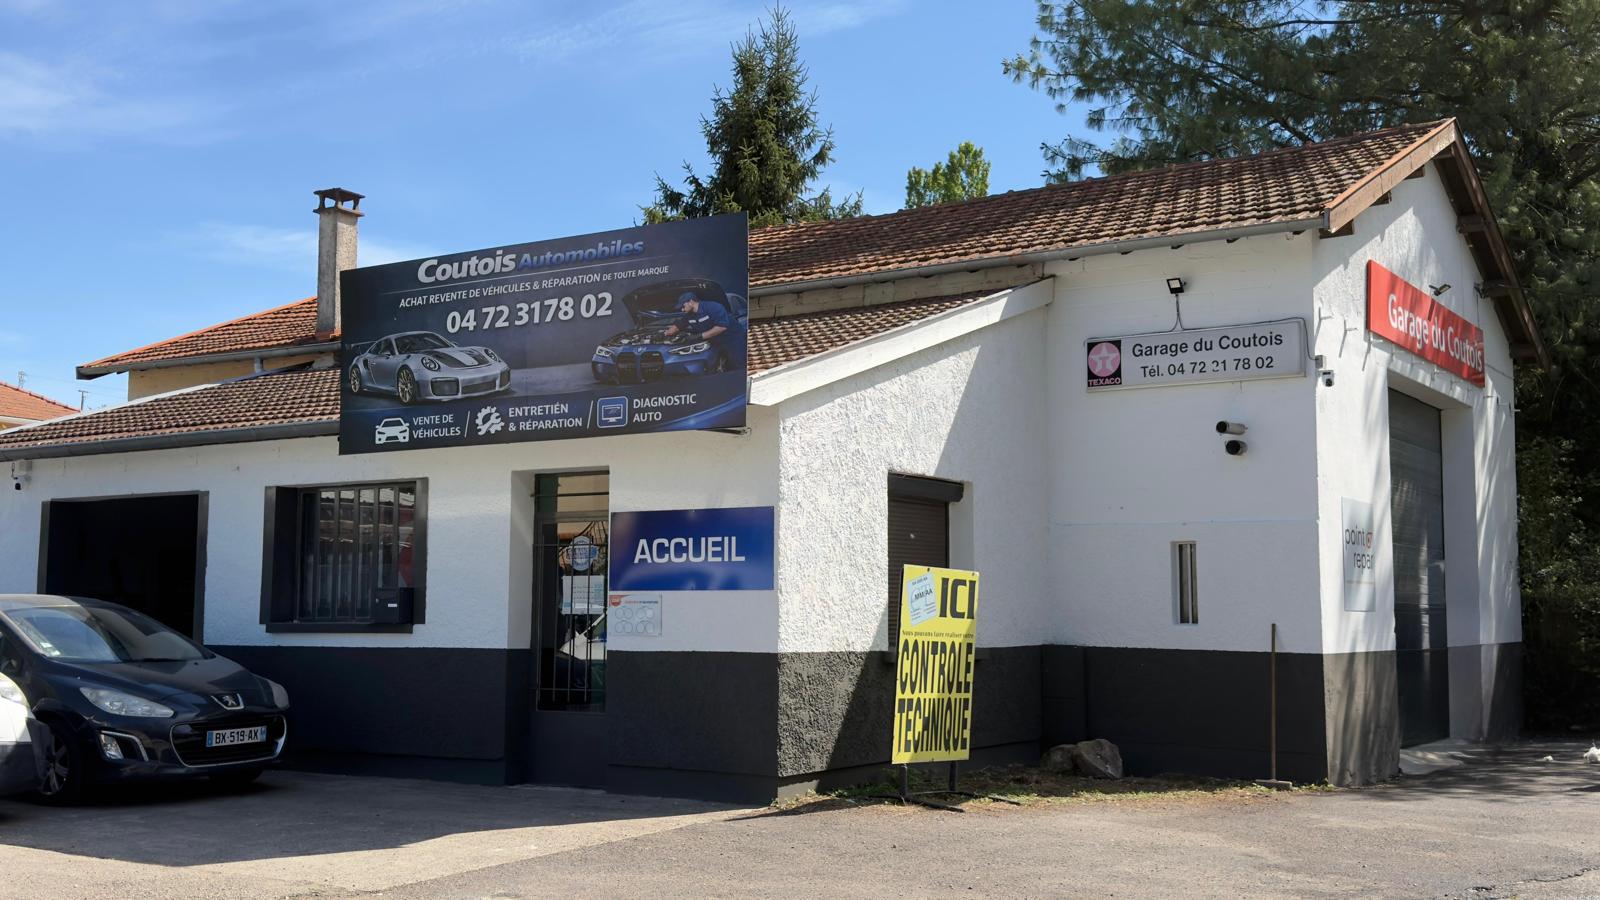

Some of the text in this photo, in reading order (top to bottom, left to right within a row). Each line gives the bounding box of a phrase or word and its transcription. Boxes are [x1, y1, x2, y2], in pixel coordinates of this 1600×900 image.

[417, 239, 645, 283] Coutois Automobiles
[399, 265, 670, 308] ACHAT REVENTE DE VÉHICULES & RÉPARATION DE TOUTE MARQUE
[446, 309, 477, 334] 04
[481, 305, 510, 330] 72
[580, 291, 613, 319] 02
[1132, 332, 1283, 357] Garage du Coutois
[1388, 294, 1483, 373] Garage du Coutois
[1141, 364, 1164, 378] Tél.
[1167, 362, 1185, 376] 04
[1190, 361, 1207, 374] 72
[1233, 357, 1251, 370] 78
[1255, 356, 1274, 369] 02
[1088, 377, 1121, 387] TEXACO
[633, 393, 697, 409] DIAGNOSTIC
[413, 414, 454, 426] VENTE DE
[508, 417, 583, 432] & RÉPARATION
[632, 411, 662, 423] AUTO
[412, 426, 461, 439] VÉHICULES
[633, 536, 746, 564] ACCUEIL
[939, 577, 977, 620] ICI
[900, 638, 973, 695] CONTROLE
[215, 729, 259, 744] BX-519-AX
[897, 696, 971, 755] TECHNIQUE
